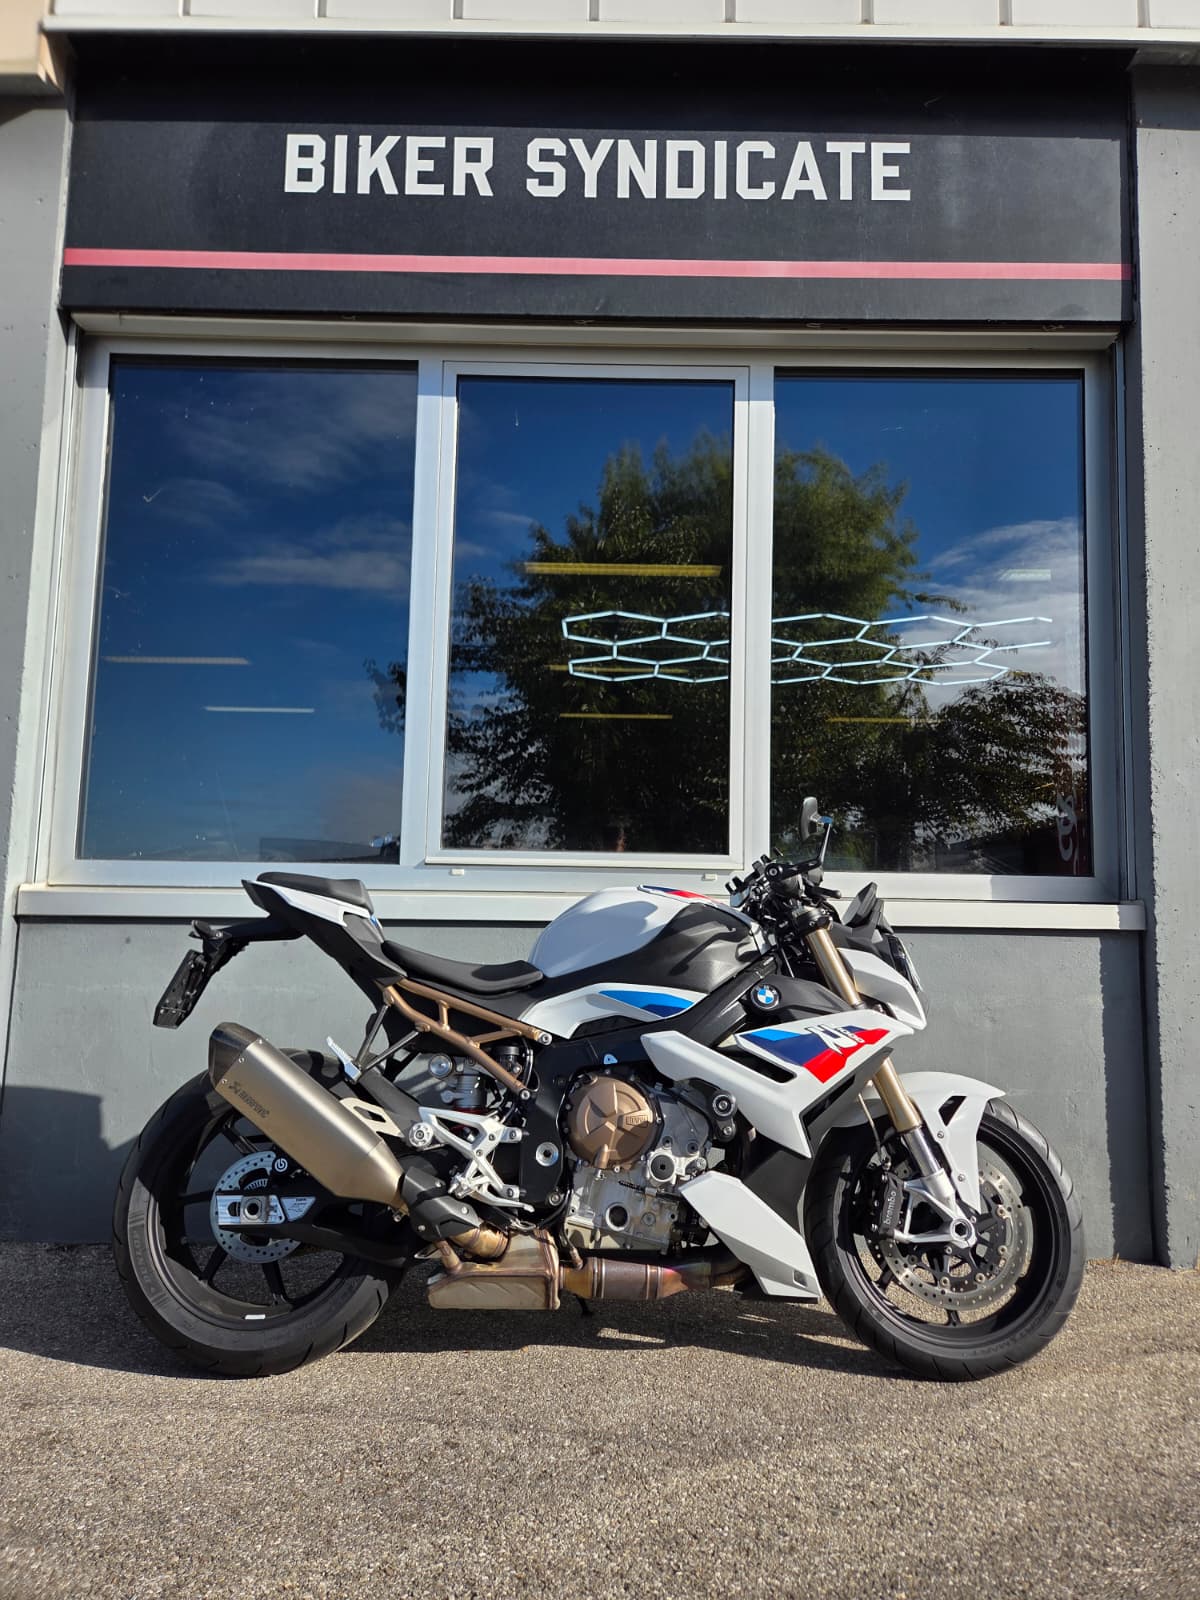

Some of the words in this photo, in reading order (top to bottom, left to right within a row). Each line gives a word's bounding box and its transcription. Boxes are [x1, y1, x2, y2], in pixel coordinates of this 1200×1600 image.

[284, 134, 494, 197] BIKER
[525, 138, 910, 201] SYNDICATE
[883, 1191, 896, 1225] brembo
